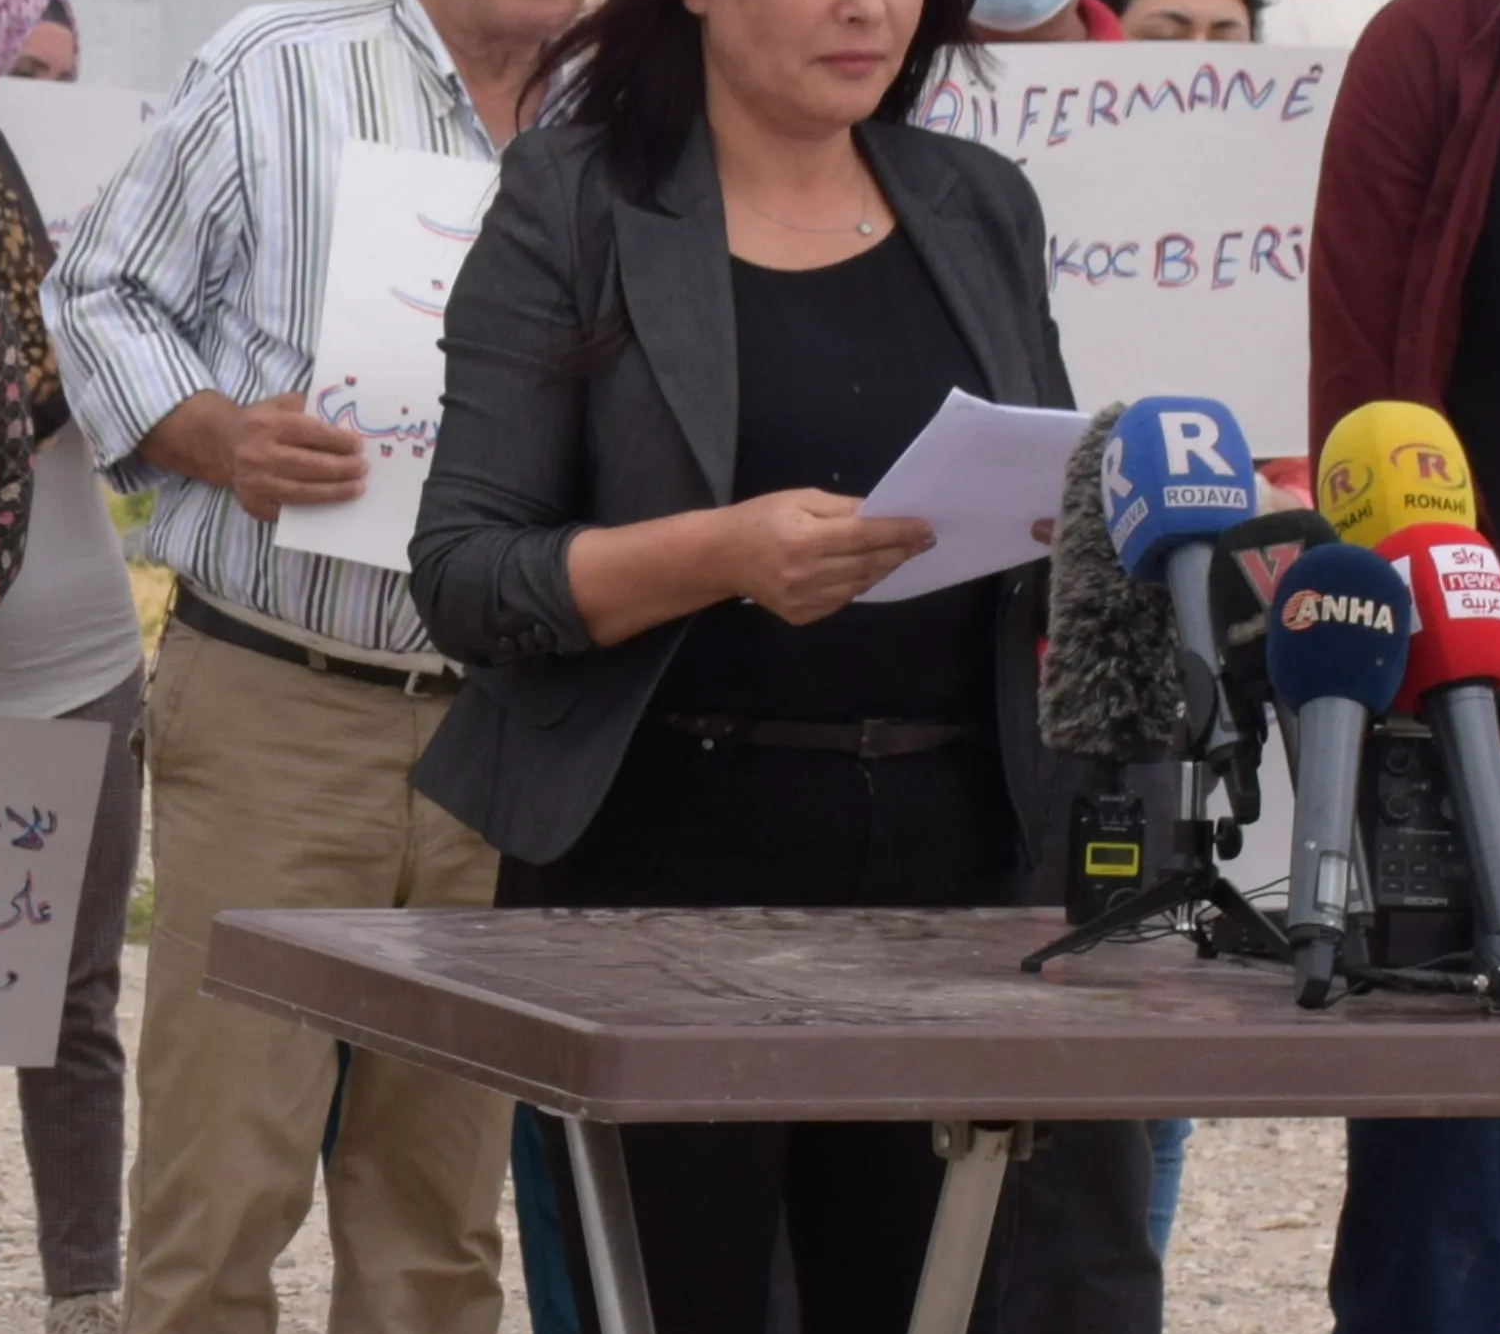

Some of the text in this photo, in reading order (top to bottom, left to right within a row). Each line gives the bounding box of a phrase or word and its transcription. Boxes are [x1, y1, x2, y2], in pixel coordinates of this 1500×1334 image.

[1158, 412, 1236, 477] R
[1417, 452, 1451, 483] R
[1166, 488, 1245, 506] ROJAVA
[1329, 467, 1356, 505] R
[1452, 547, 1485, 569] sky
[1293, 594, 1395, 635] ANHA
[1462, 593, 1500, 614] عربية
